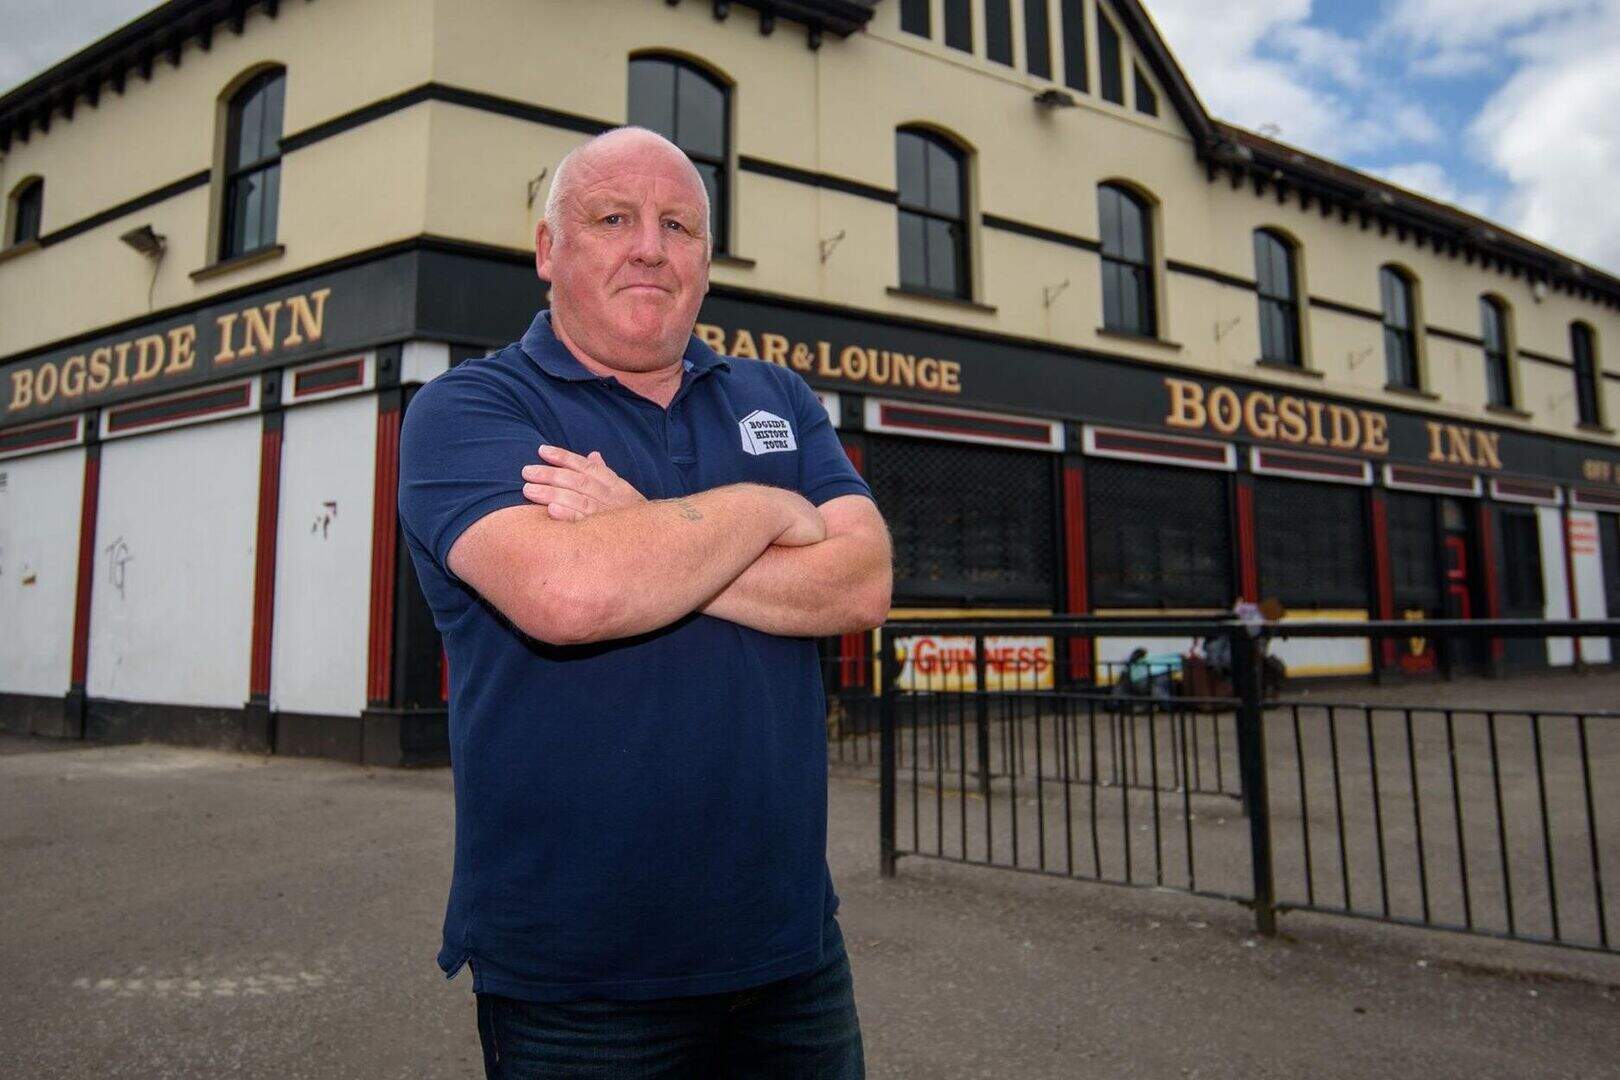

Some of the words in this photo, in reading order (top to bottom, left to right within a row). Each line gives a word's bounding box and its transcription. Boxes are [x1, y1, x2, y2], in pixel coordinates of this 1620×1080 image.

[8, 324, 197, 411] BOGSIDE
[214, 288, 331, 364] INN
[749, 421, 786, 429] BOGSIDE
[1164, 377, 1390, 455] BOGSIDE
[1425, 420, 1503, 470] INN
[754, 430, 788, 439] HISTORY
[763, 440, 788, 450] TOURS
